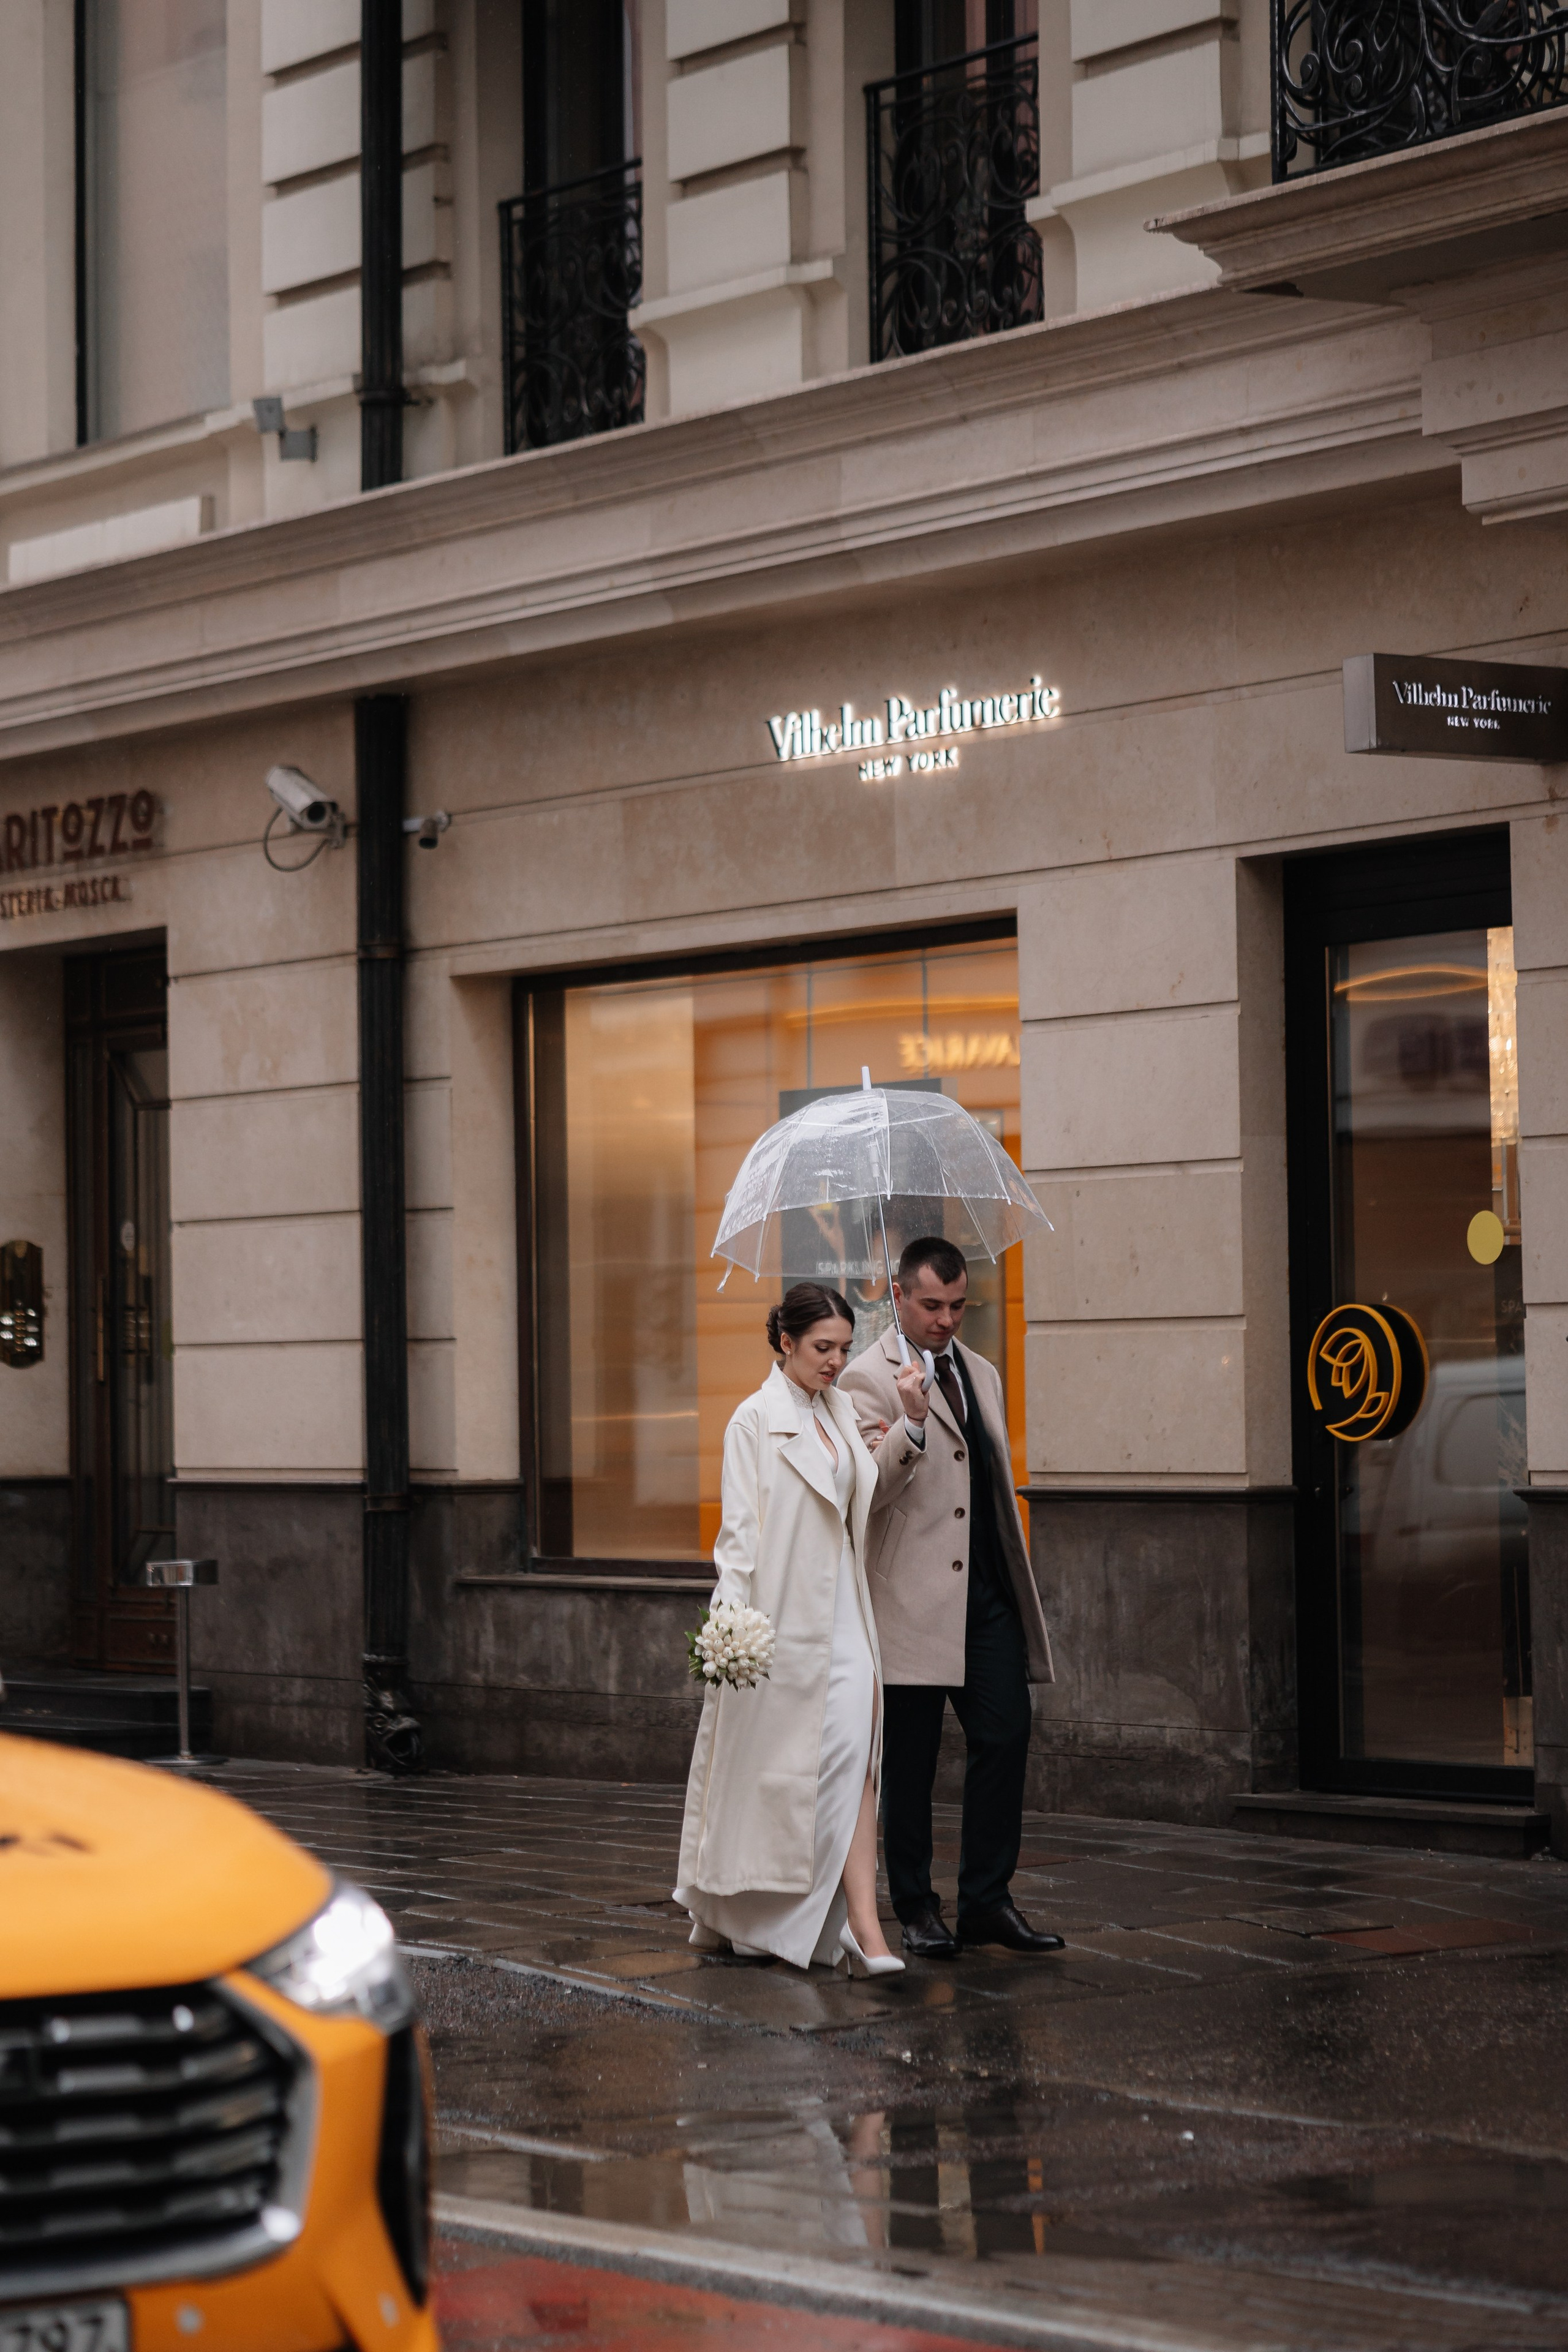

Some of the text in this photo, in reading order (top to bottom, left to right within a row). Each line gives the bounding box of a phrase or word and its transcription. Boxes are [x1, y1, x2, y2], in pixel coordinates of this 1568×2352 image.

[1392, 680, 1551, 714] Vilhelm Parfumerie
[767, 675, 1060, 761] Vilhelm Parfumerie
[1447, 715, 1500, 729] NEW YORK
[859, 747, 959, 782] NEW YORK
[0, 790, 153, 873] RITOZZO
